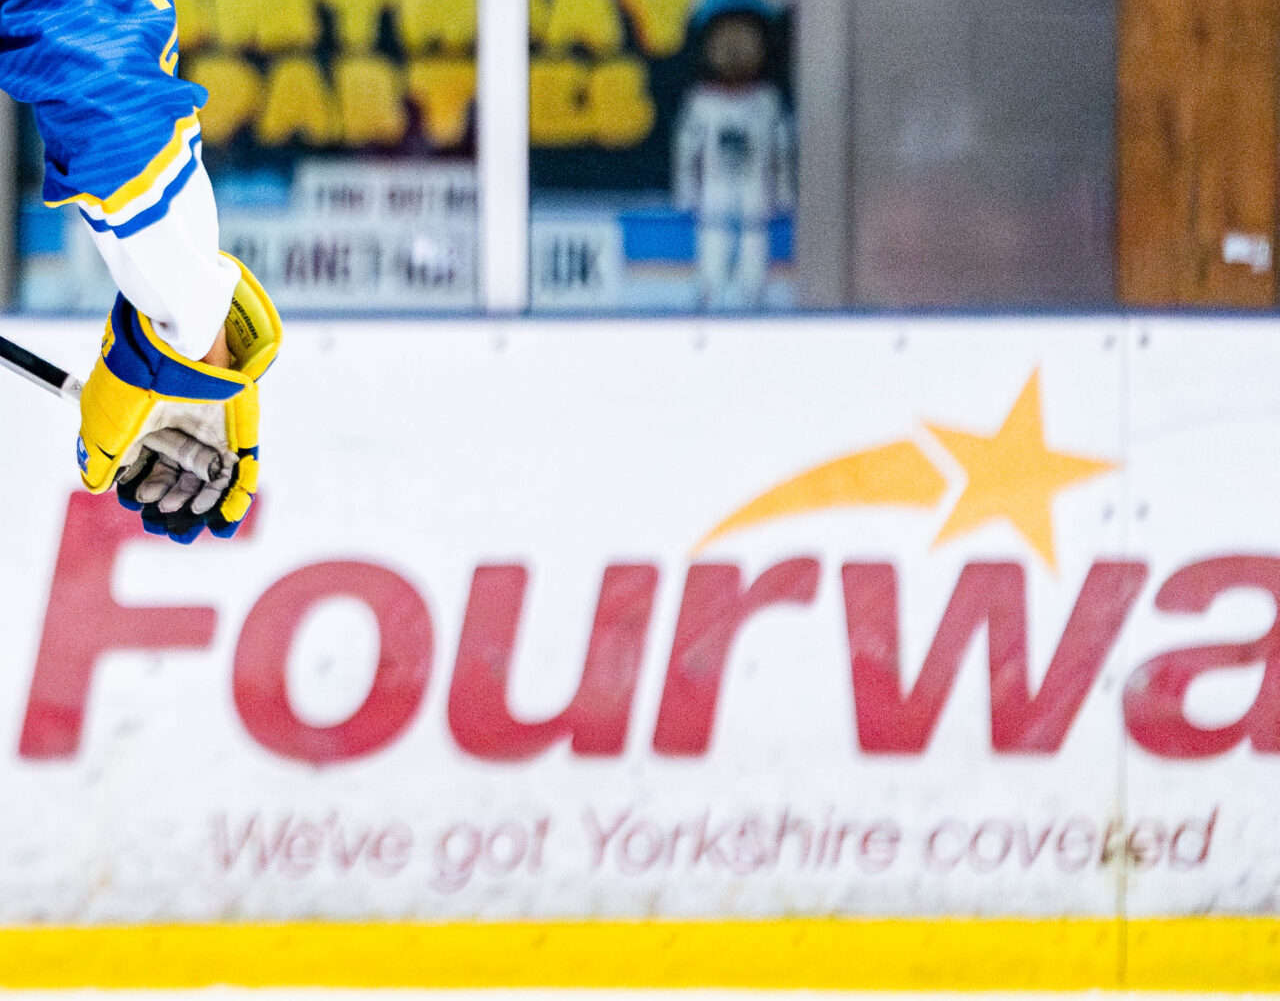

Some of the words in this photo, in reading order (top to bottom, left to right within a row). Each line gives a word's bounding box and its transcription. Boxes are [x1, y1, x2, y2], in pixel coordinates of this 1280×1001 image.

[189, 53, 656, 147] PARTES
[209, 805, 415, 879] We've
[428, 811, 552, 894] got
[580, 801, 902, 879] Yorkshire
[925, 802, 1220, 875] covered
